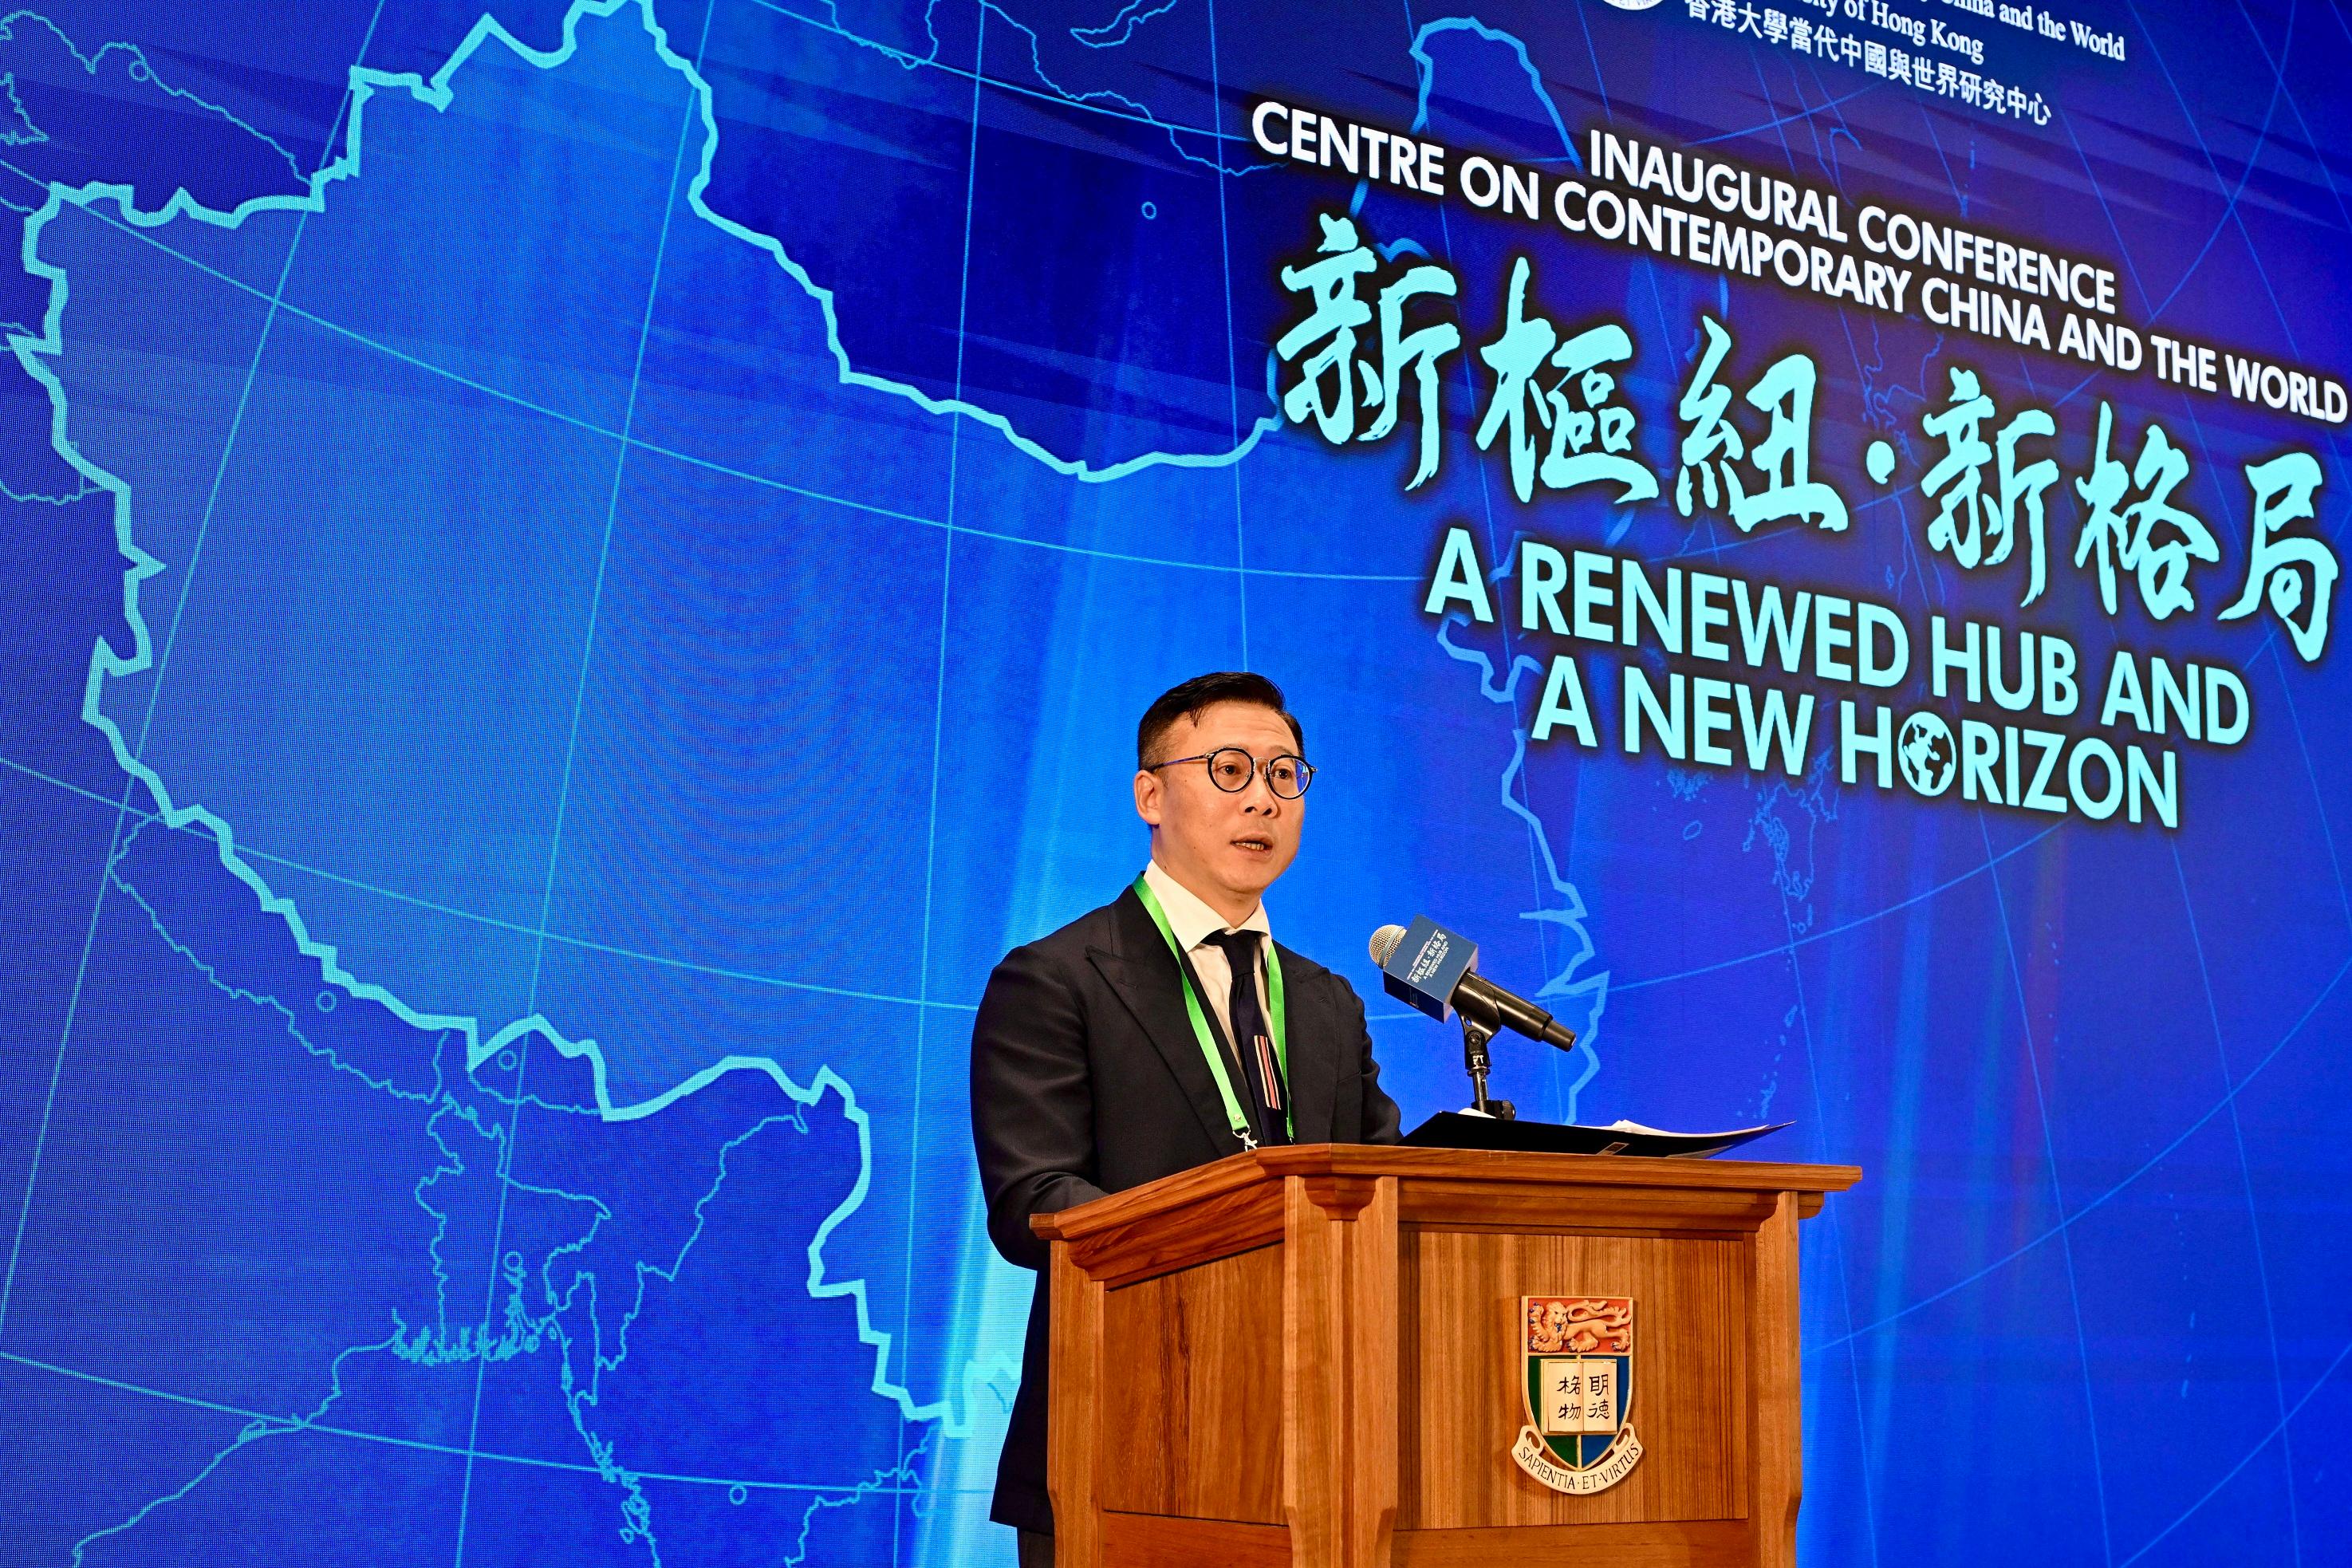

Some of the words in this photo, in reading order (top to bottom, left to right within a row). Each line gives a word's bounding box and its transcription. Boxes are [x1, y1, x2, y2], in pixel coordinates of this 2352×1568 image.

[1844, 0, 1865, 22] of
[1872, 2, 1925, 46] Hong
[1930, 19, 1984, 65] Kong
[1999, 4, 2034, 31] and
[2038, 11, 2066, 41] the
[2070, 21, 2125, 61] World
[1252, 101, 1444, 195] CENTRE
[1460, 156, 1539, 220] ON
[1554, 182, 1913, 313] CONTEMPORARY
[1921, 277, 2051, 350] CHINA
[2058, 313, 2142, 371] AND
[2151, 335, 2217, 392] THE
[2225, 355, 2348, 424] WORLD
[1590, 130, 1847, 242] INAUGURAL
[1858, 205, 2115, 314] CONFERENCE
[1424, 527, 1494, 623] A
[1522, 541, 1909, 687] RENEWED
[1932, 615, 2078, 716] HUB
[2101, 651, 2249, 745] AND
[1531, 655, 1598, 747] A
[1624, 666, 1814, 777] NEW
[1518, 1446, 1576, 1490] SAPIENTIA
[1582, 1475, 1597, 1490] ET
[1601, 1443, 1640, 1483] VIRTUS
